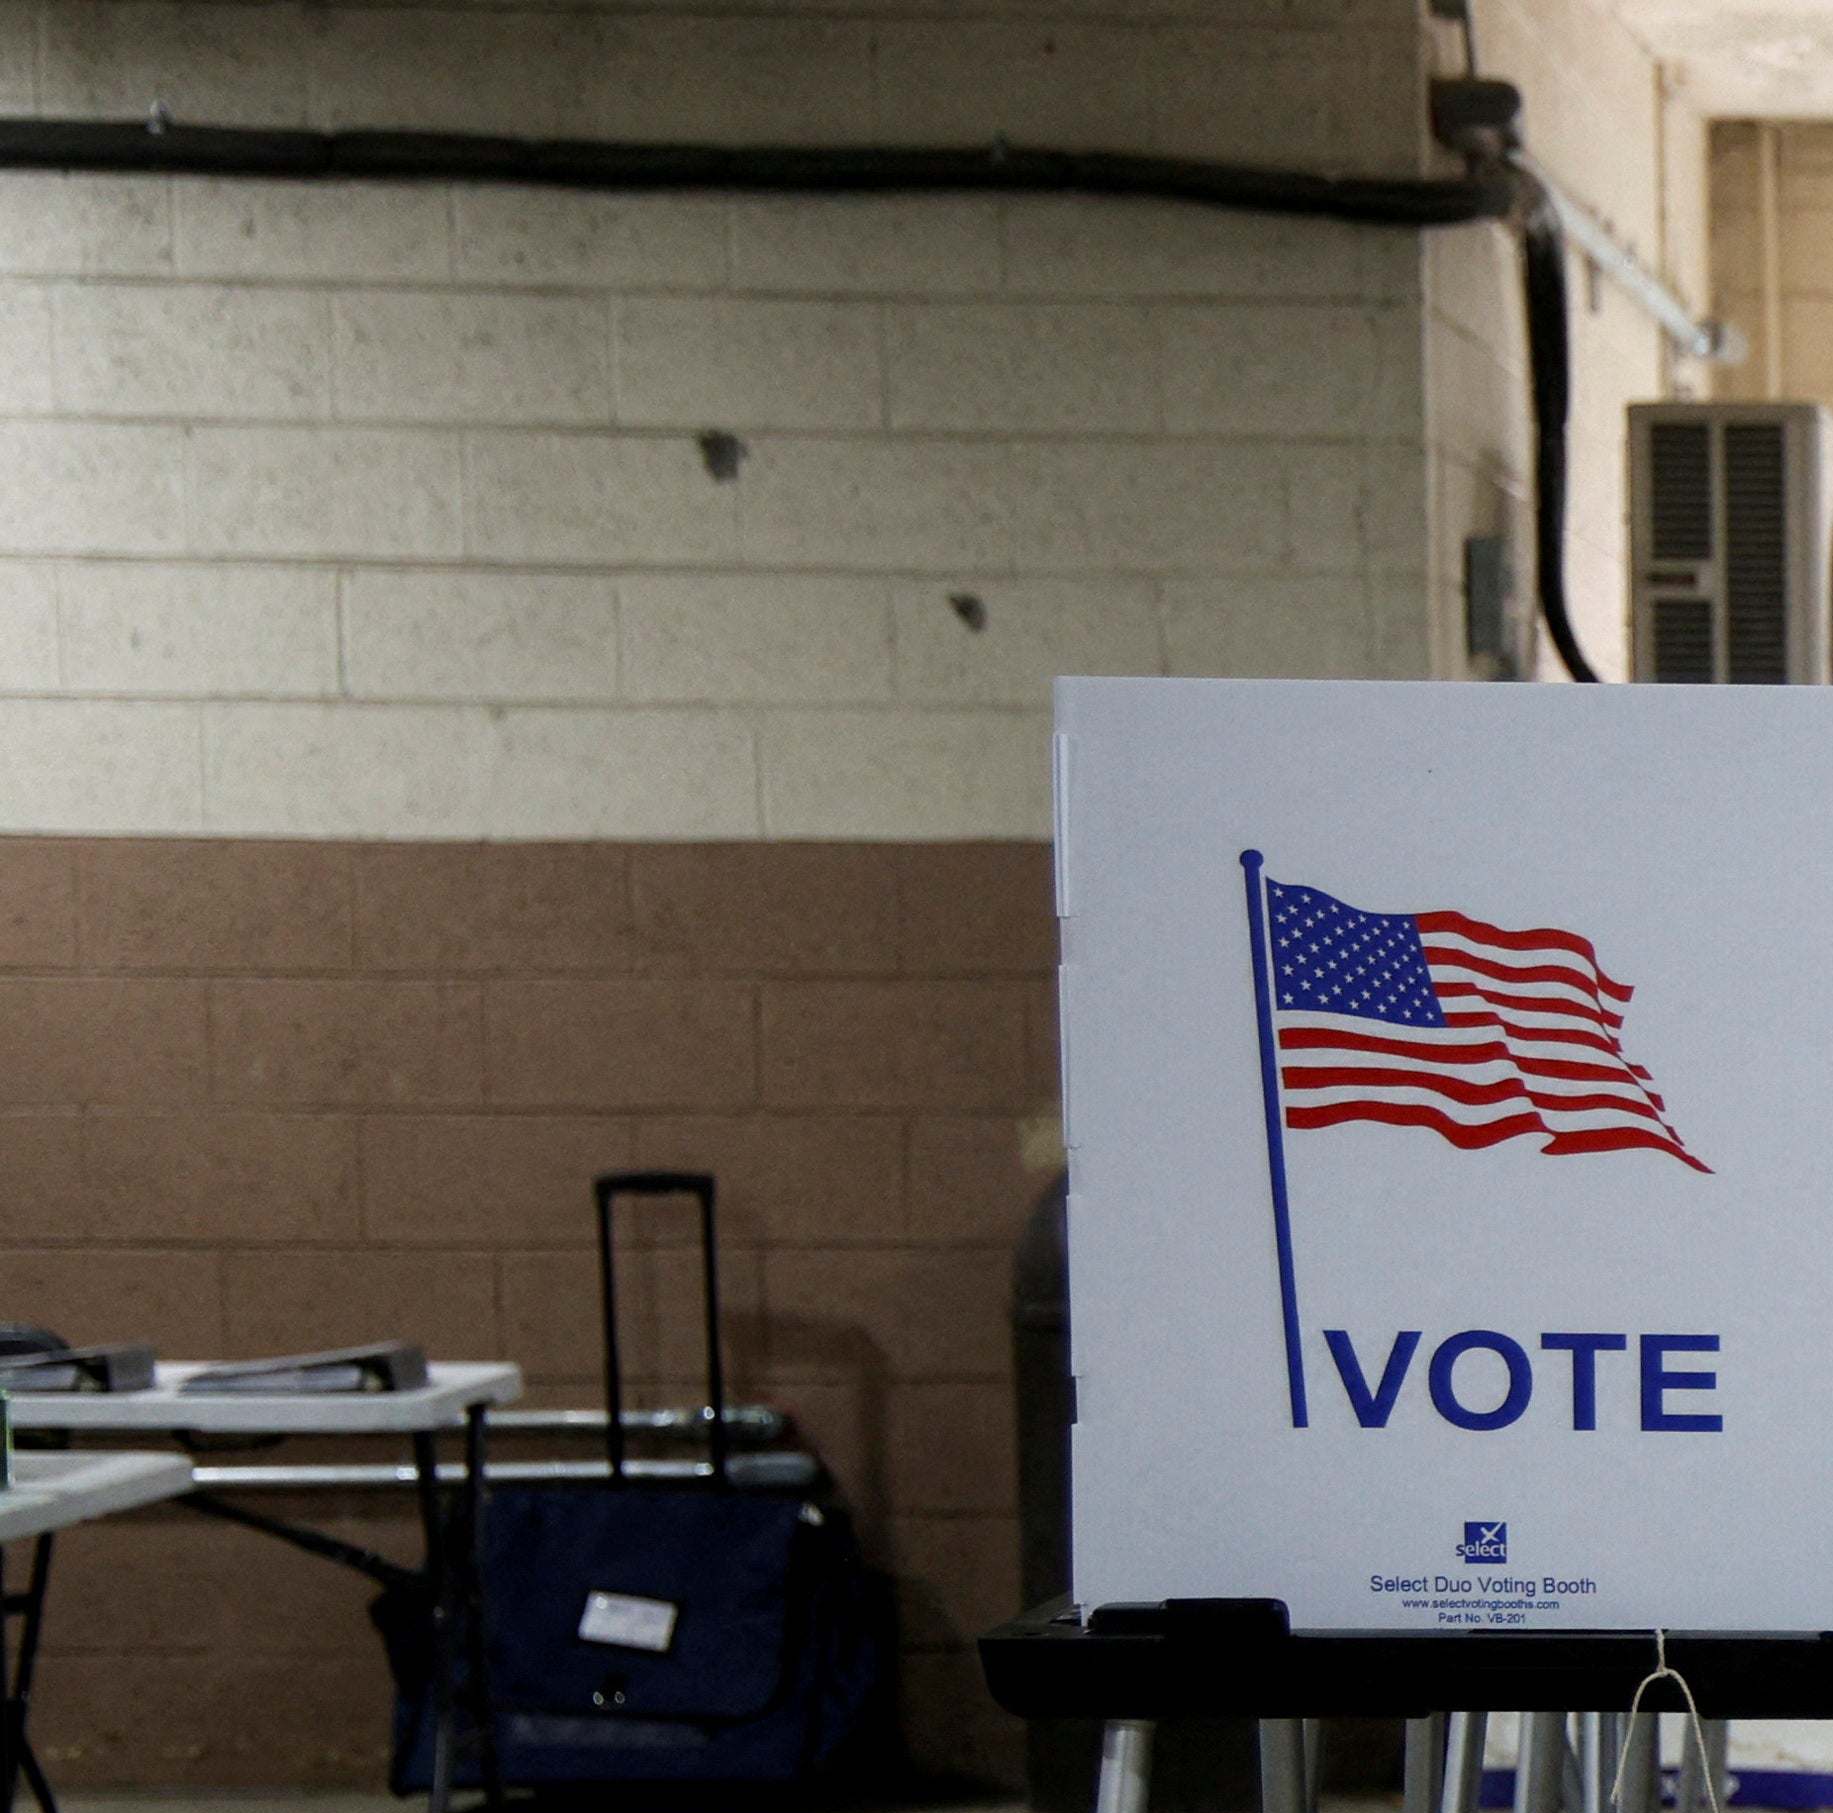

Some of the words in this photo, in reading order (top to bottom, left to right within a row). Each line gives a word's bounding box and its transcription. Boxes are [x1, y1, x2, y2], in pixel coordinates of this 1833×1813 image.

[1323, 1330, 1724, 1432] VOTE
[1456, 1541, 1506, 1557] select
[1370, 1576, 1428, 1593] Select
[1434, 1577, 1472, 1593] Duo
[1477, 1577, 1536, 1597] Voting
[1543, 1578, 1597, 1594] Booth
[1402, 1598, 1559, 1611] www.selectvotingbooths.com
[1438, 1613, 1462, 1624] Part
[1487, 1613, 1526, 1624] VB-201
